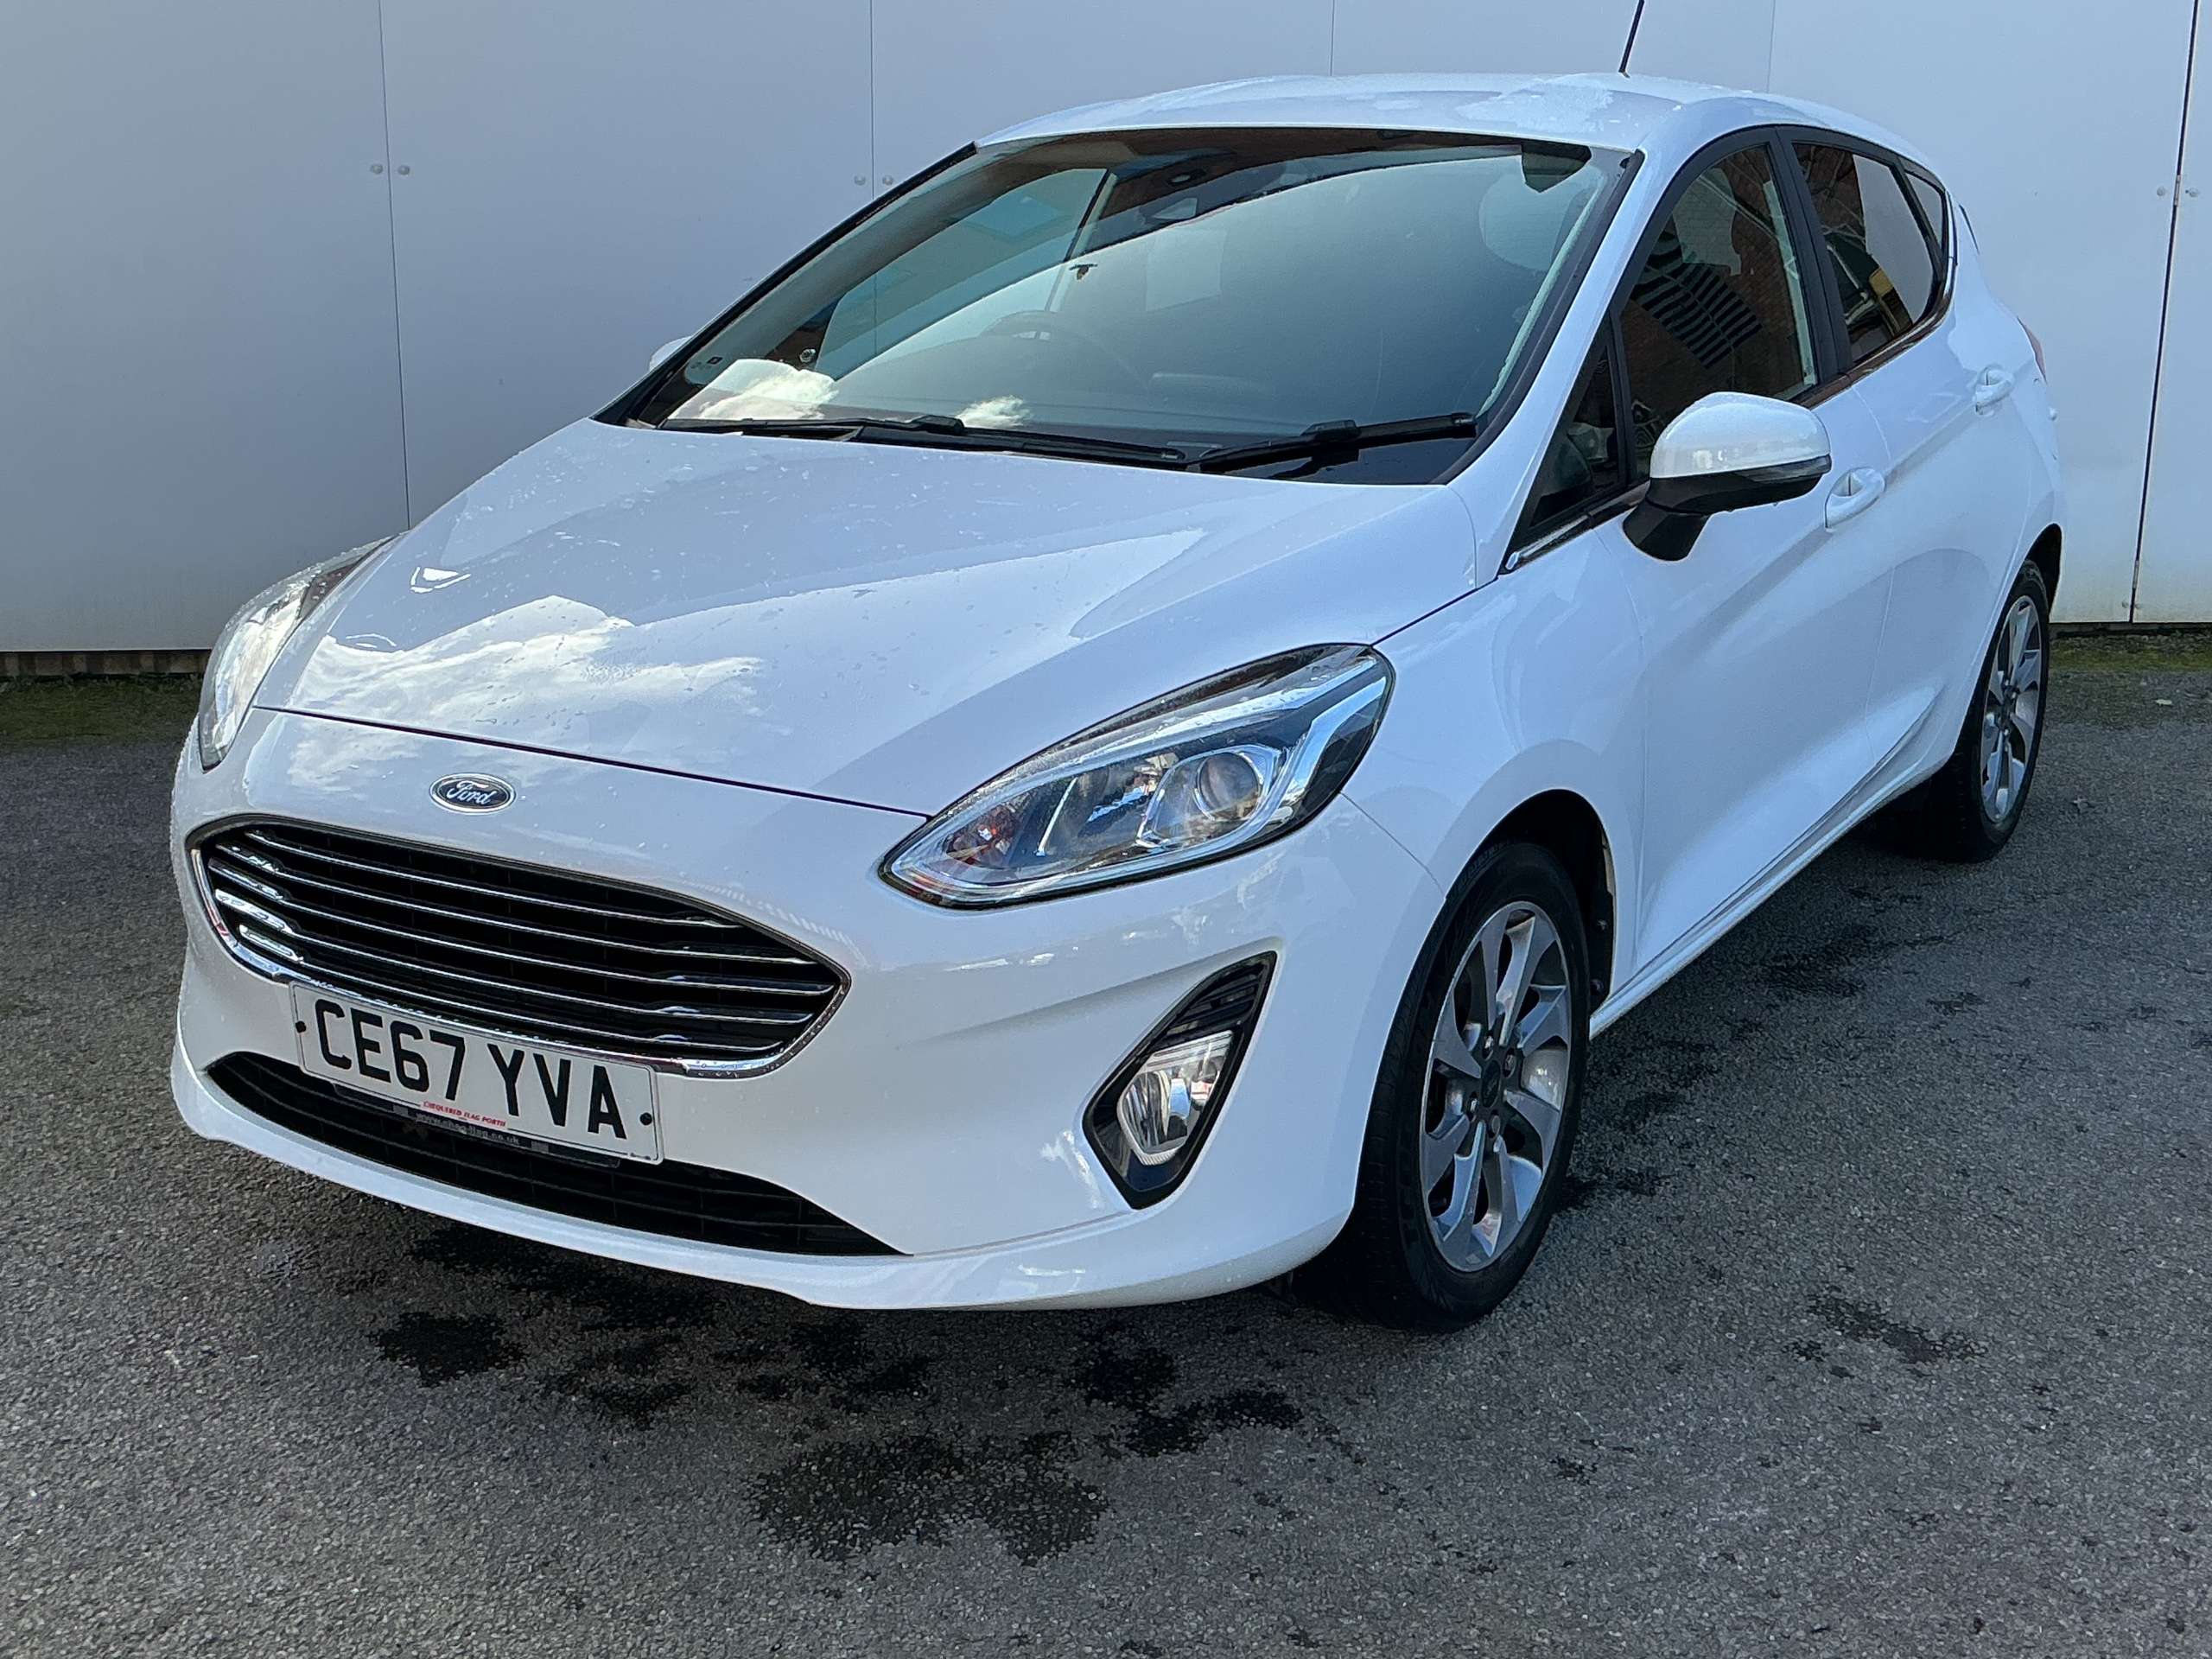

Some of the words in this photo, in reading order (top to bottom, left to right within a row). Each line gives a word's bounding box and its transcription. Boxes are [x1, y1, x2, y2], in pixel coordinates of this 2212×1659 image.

[446, 780, 498, 805] Ford
[314, 998, 466, 1102] CE67
[486, 1043, 628, 1141] YVA
[463, 1111, 480, 1121] FLAG
